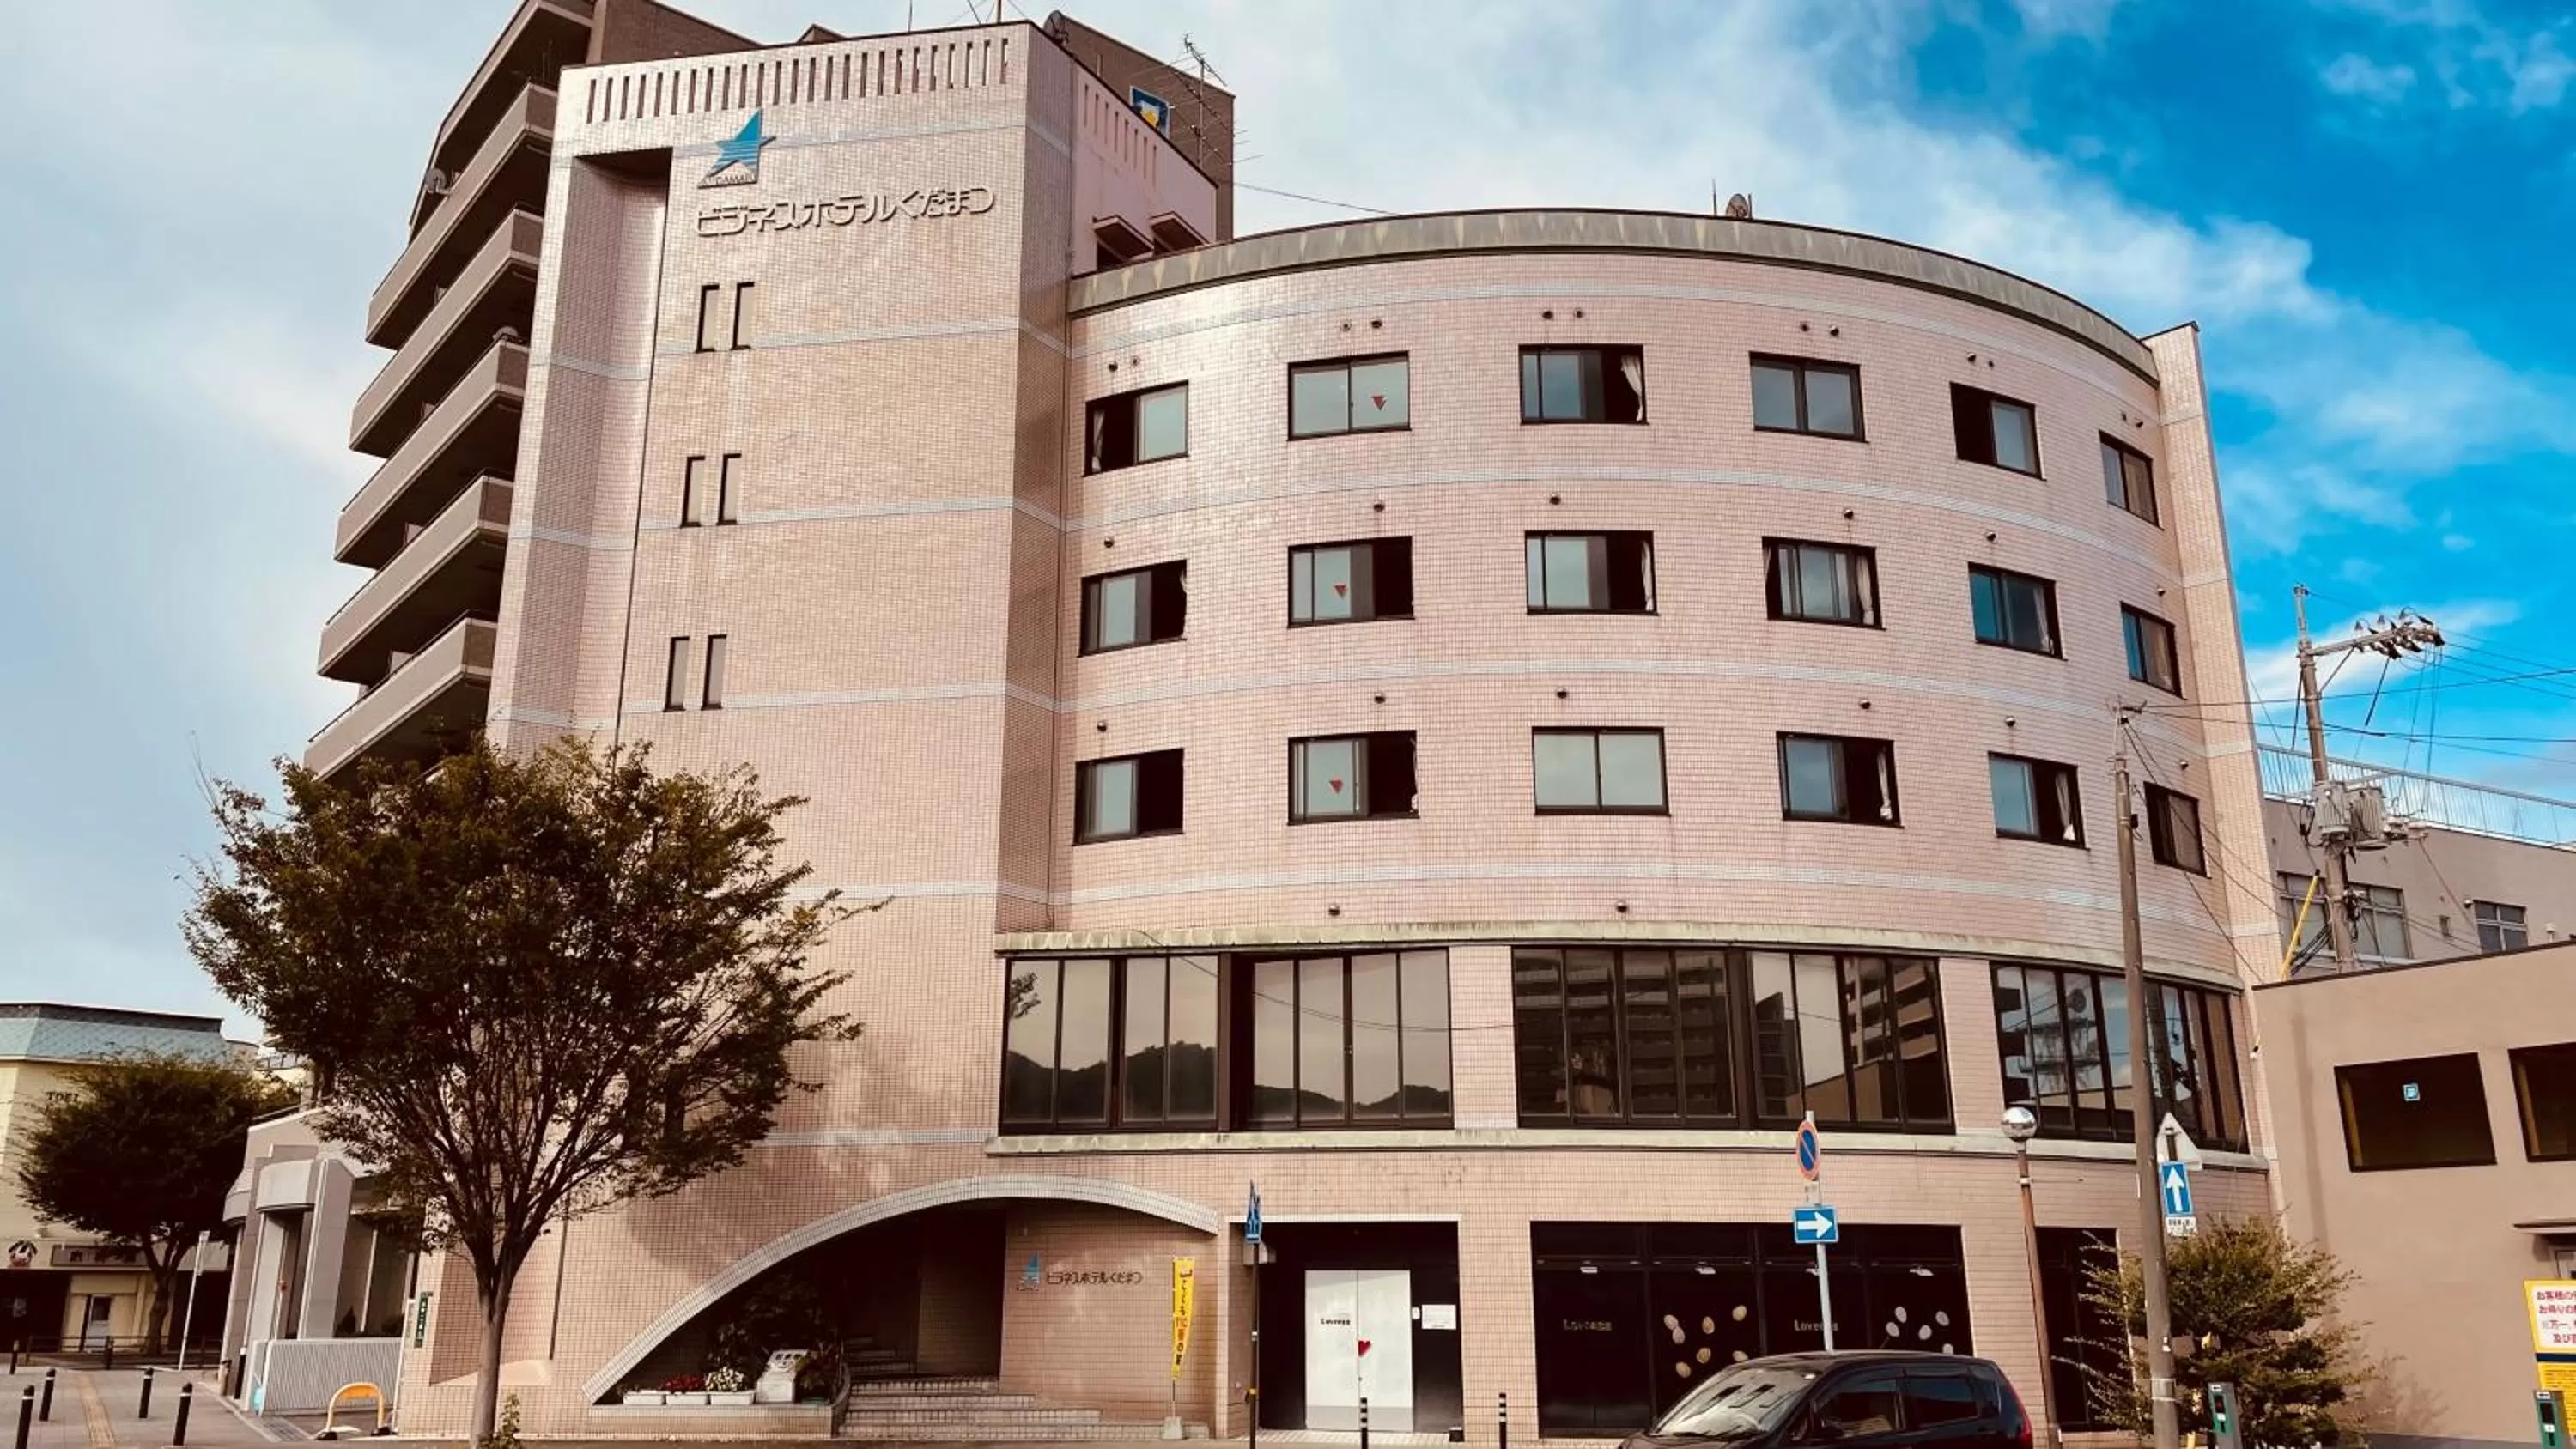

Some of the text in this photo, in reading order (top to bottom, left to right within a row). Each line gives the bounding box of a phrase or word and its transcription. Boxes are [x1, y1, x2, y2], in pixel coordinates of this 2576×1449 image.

[696, 187, 996, 236] ビジネスホテルくだまつ
